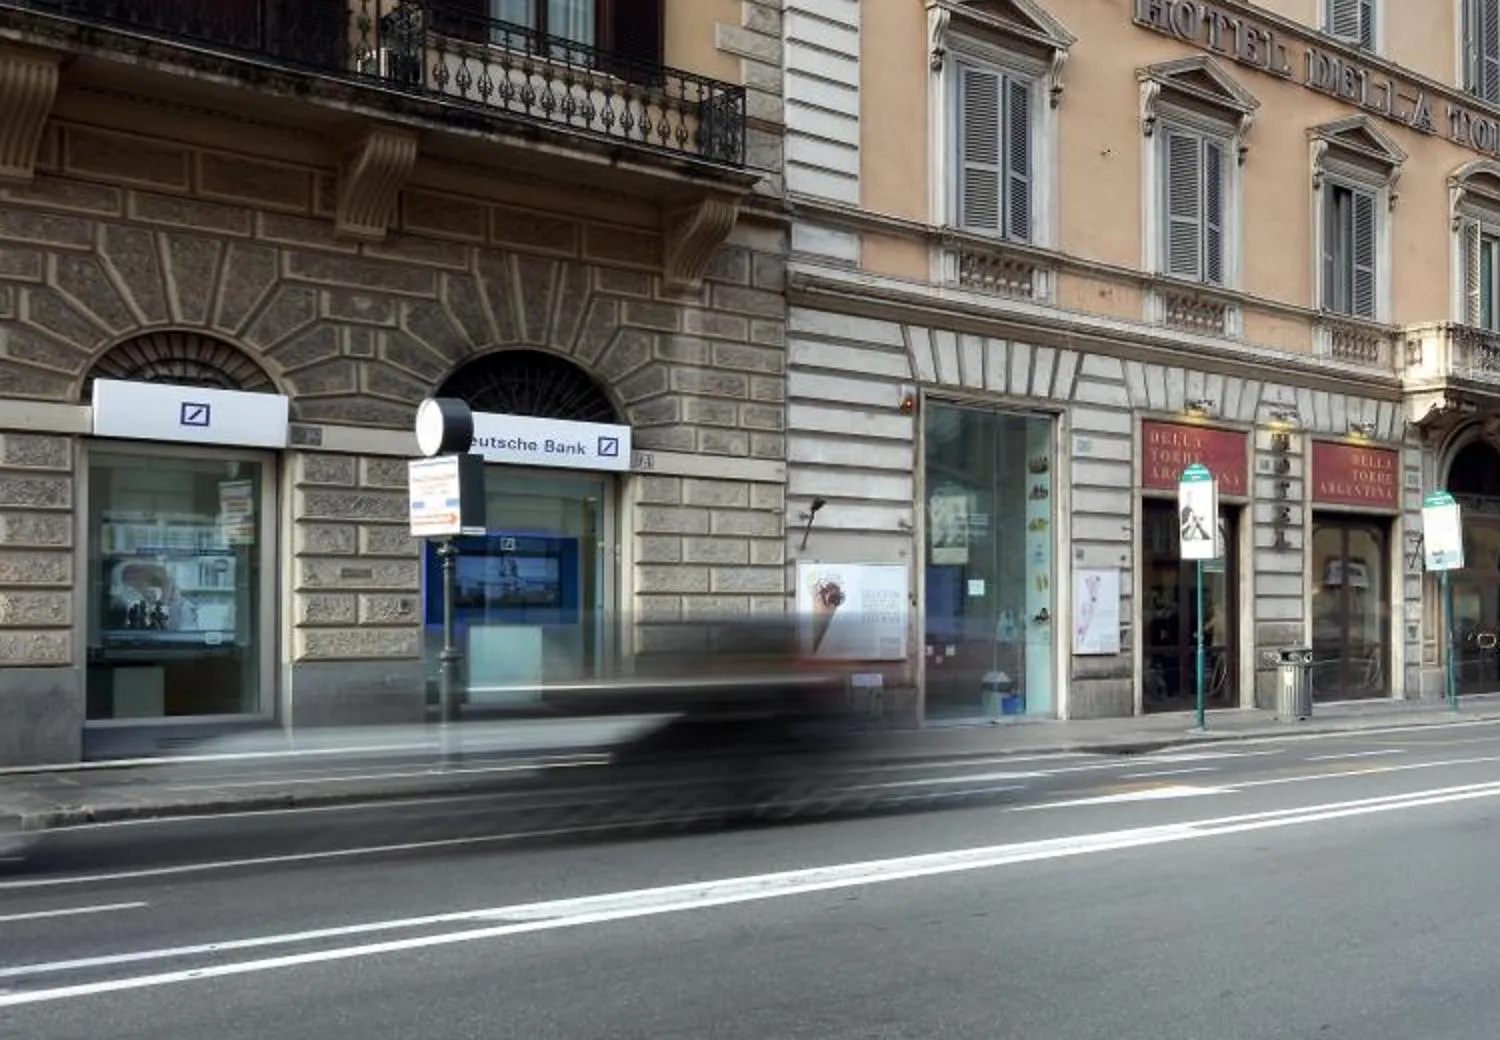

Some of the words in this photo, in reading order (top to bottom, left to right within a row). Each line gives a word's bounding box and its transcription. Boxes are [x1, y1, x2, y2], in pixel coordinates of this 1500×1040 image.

[1303, 47, 1437, 135] DELLA
[470, 435, 537, 452] eutsche
[543, 438, 587, 456] Bank
[1150, 430, 1202, 449] DELLA
[1351, 454, 1392, 470] DELLA
[1352, 469, 1393, 485] TORRE
[1320, 480, 1393, 500] ARGENTINA
